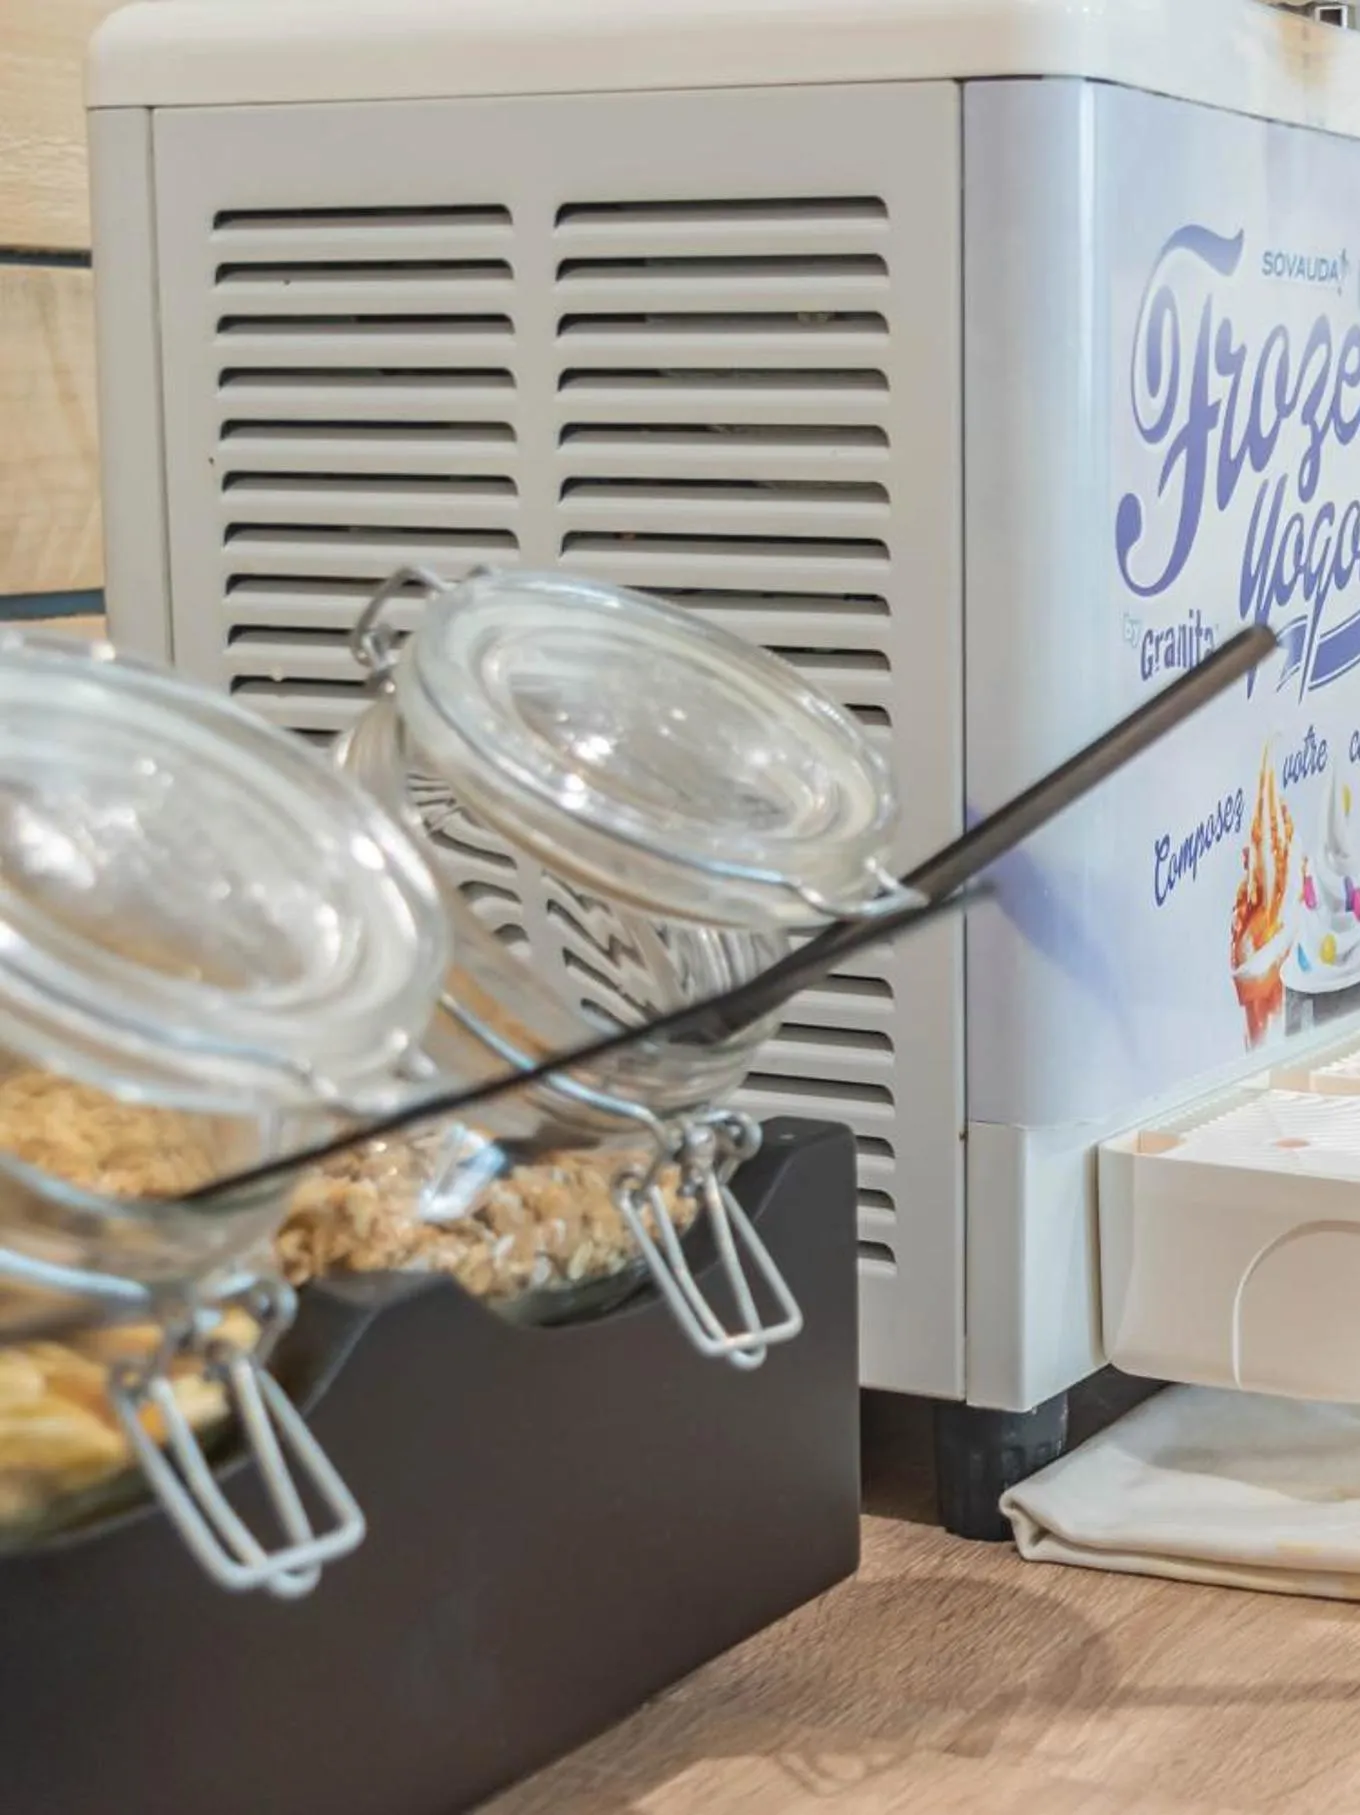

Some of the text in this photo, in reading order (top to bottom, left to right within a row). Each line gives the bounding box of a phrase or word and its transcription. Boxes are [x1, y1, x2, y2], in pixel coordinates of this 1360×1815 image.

[1261, 250, 1340, 282] SOVAUDA
[1140, 608, 1216, 682] Granita
[1154, 787, 1245, 908] Composez
[1282, 724, 1328, 789] votre
